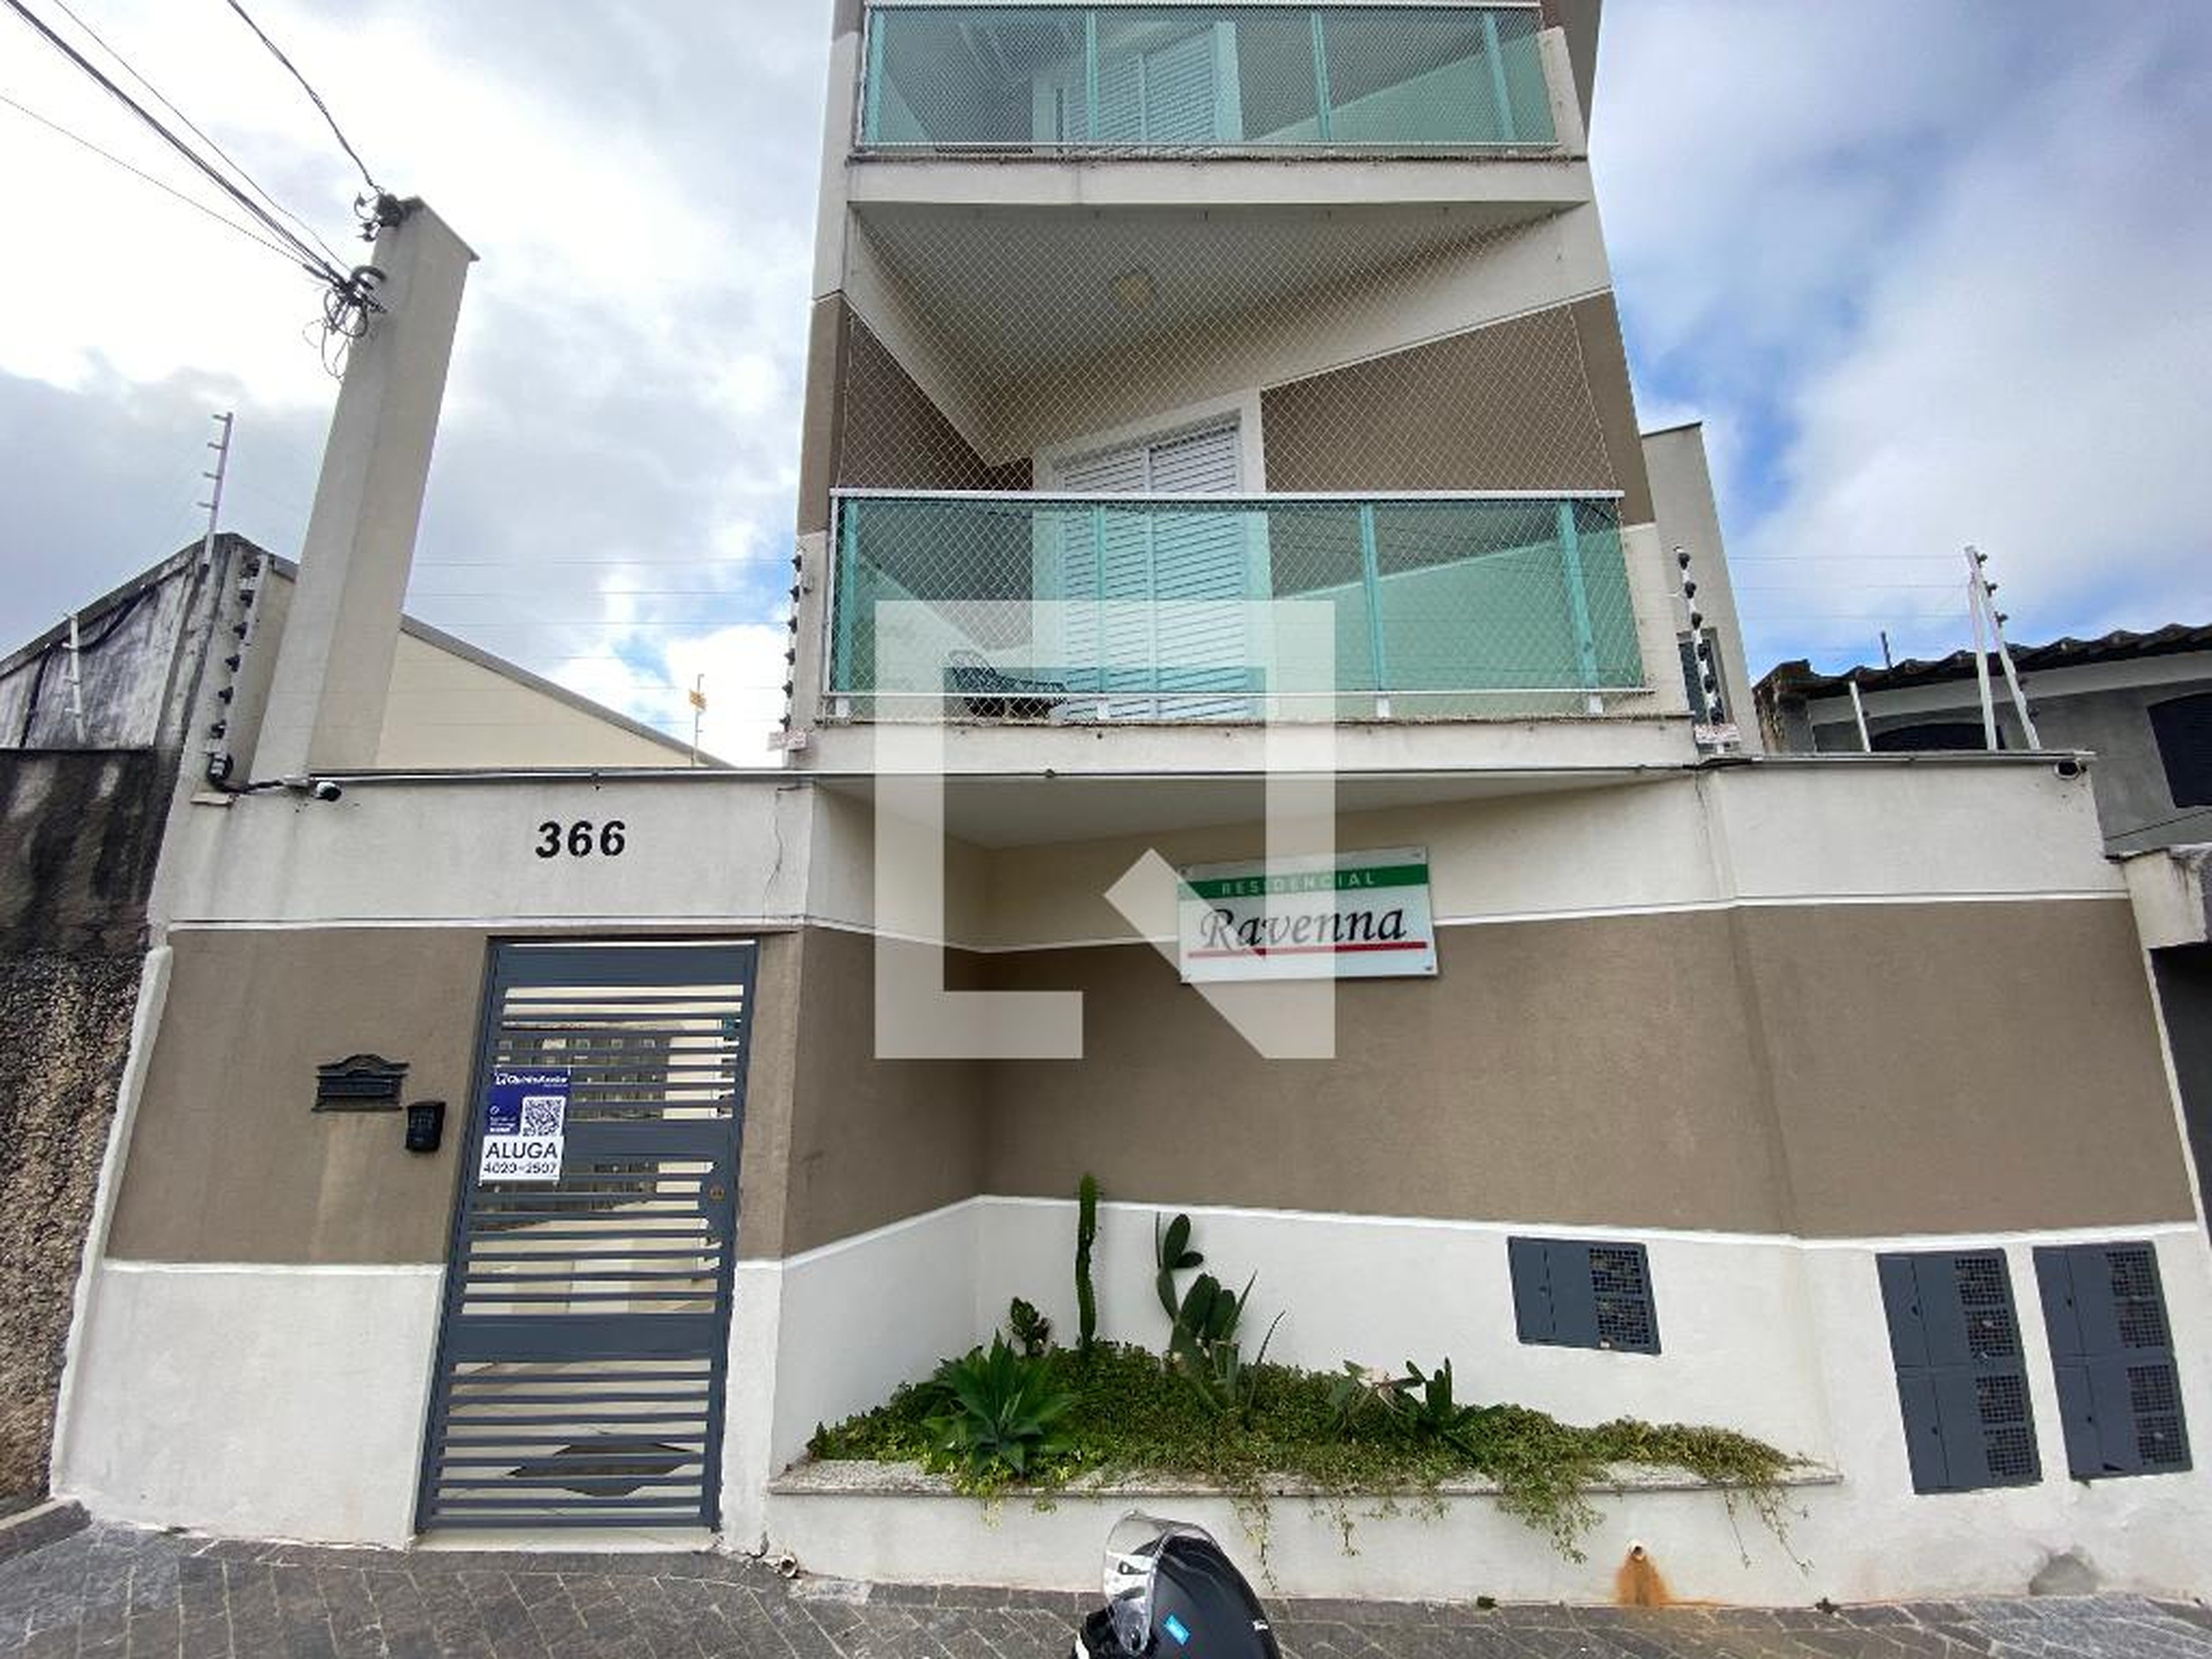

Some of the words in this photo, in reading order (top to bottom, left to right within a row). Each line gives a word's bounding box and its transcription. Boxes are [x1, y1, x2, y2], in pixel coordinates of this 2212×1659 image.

[535, 821, 626, 858] 366
[1221, 871, 1376, 896] RESDENCIAL
[1200, 907, 1407, 952] Ravenna
[486, 1142, 558, 1159] ALUGA
